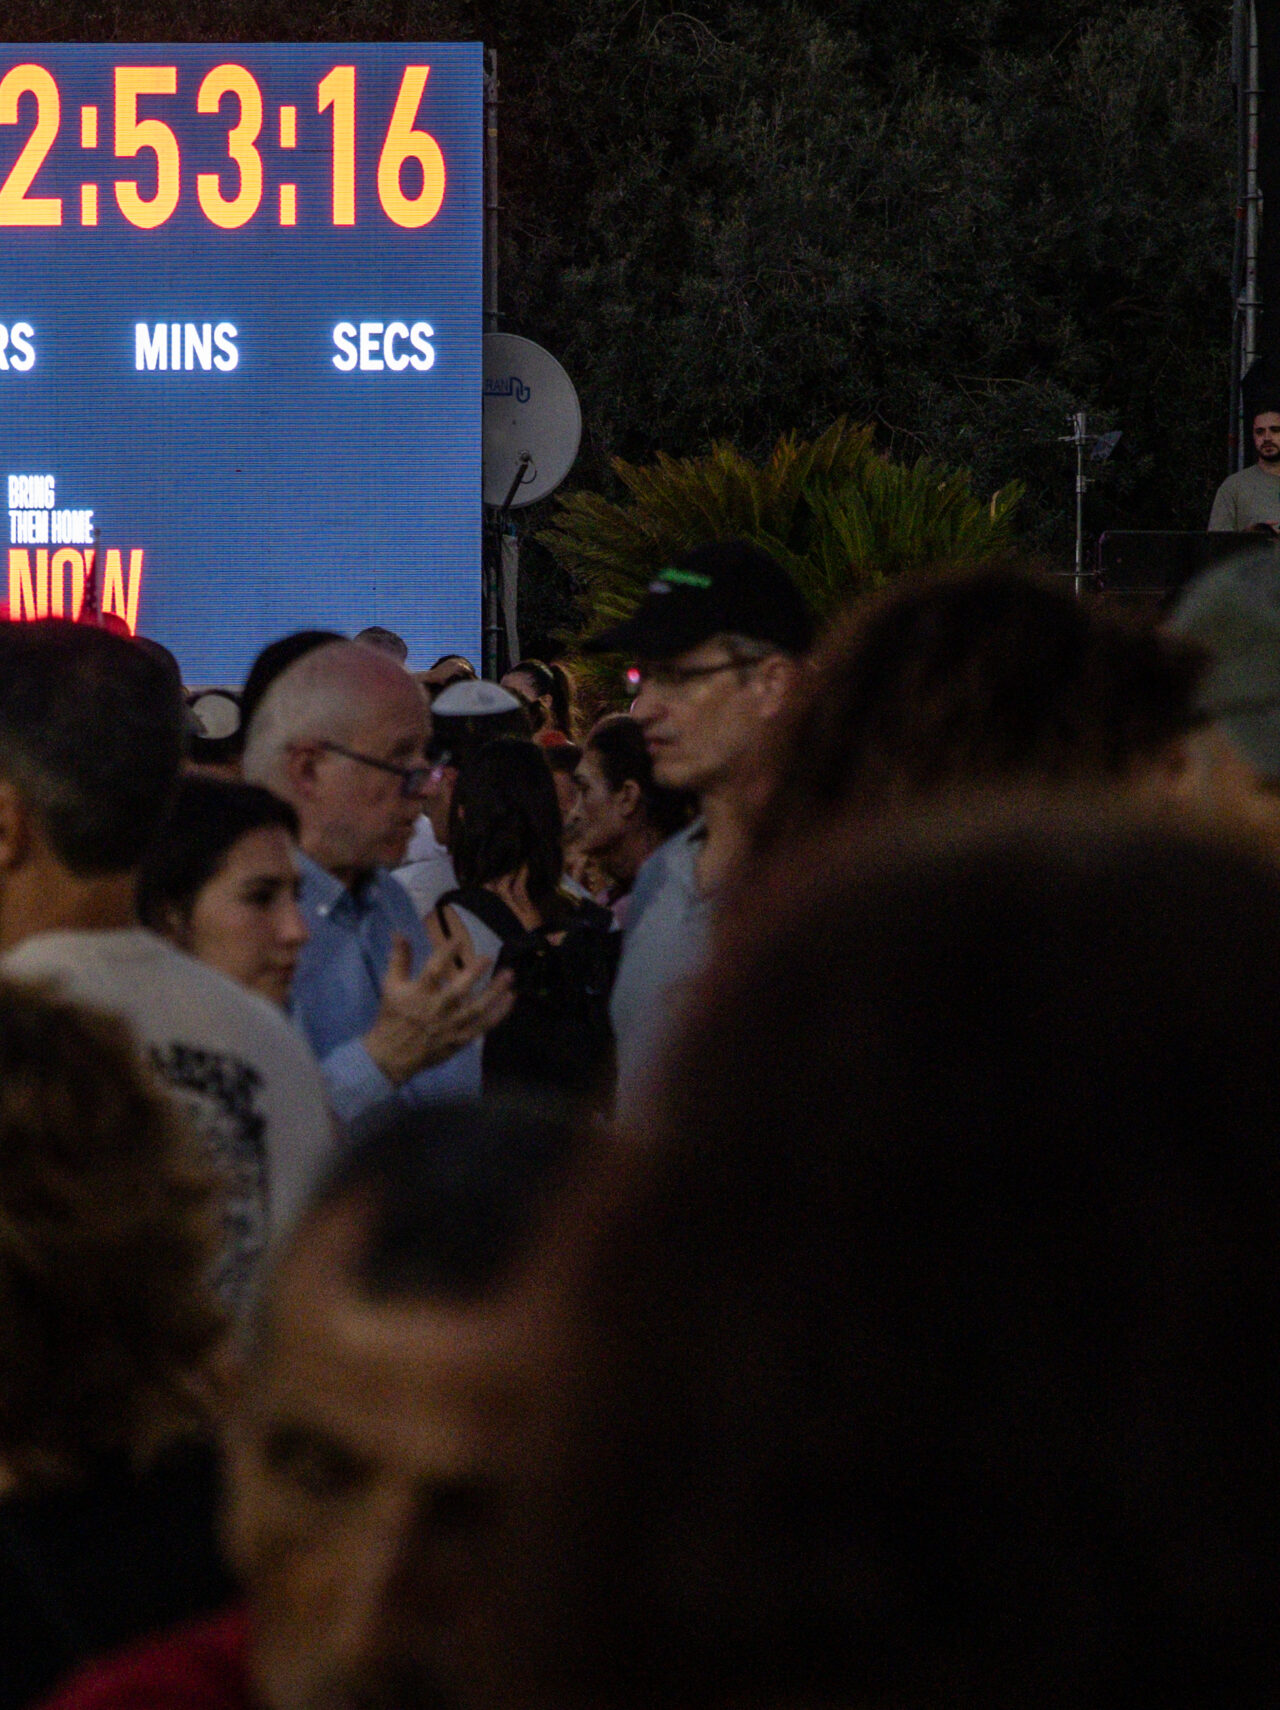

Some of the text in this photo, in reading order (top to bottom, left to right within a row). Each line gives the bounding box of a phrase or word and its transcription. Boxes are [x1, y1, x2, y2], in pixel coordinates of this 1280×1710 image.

[135, 322, 239, 372] MINS
[332, 321, 435, 372] SECS
[8, 474, 55, 509] BRING
[8, 509, 95, 544] THEM HOME
[8, 547, 145, 637] NOW
